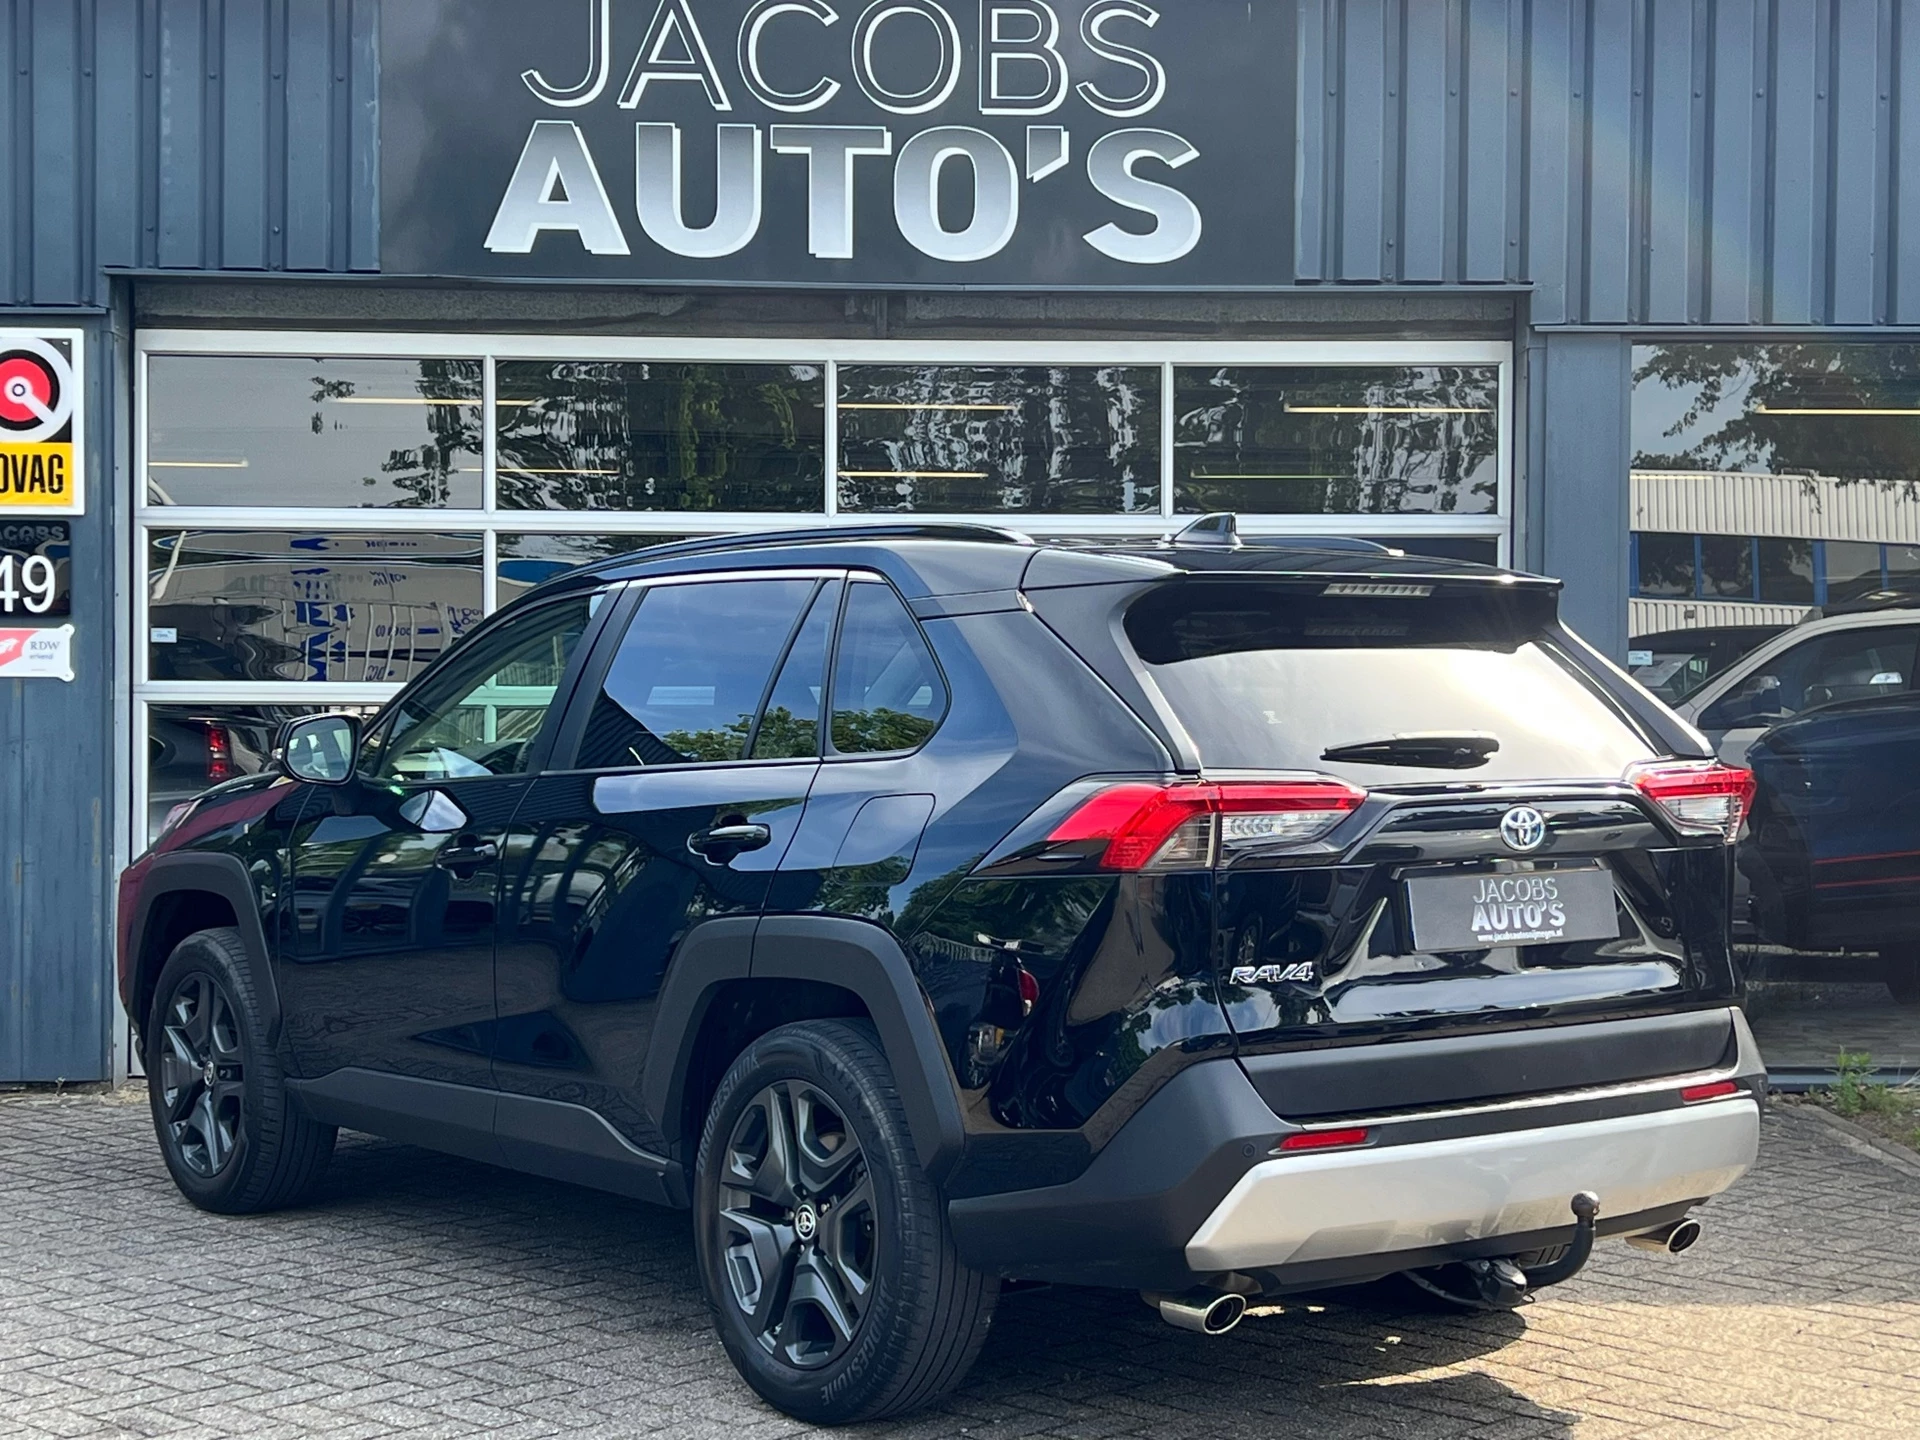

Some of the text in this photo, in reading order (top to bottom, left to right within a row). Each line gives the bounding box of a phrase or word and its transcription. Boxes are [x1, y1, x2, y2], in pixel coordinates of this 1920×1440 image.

[520, 0, 1166, 118] JACOBS
[483, 119, 1203, 264] AUTO'S
[30, 641, 61, 651] RDW
[1472, 876, 1559, 904] JACOBS
[1471, 900, 1566, 931] AUTO'S
[1229, 961, 1315, 985] RAV4
